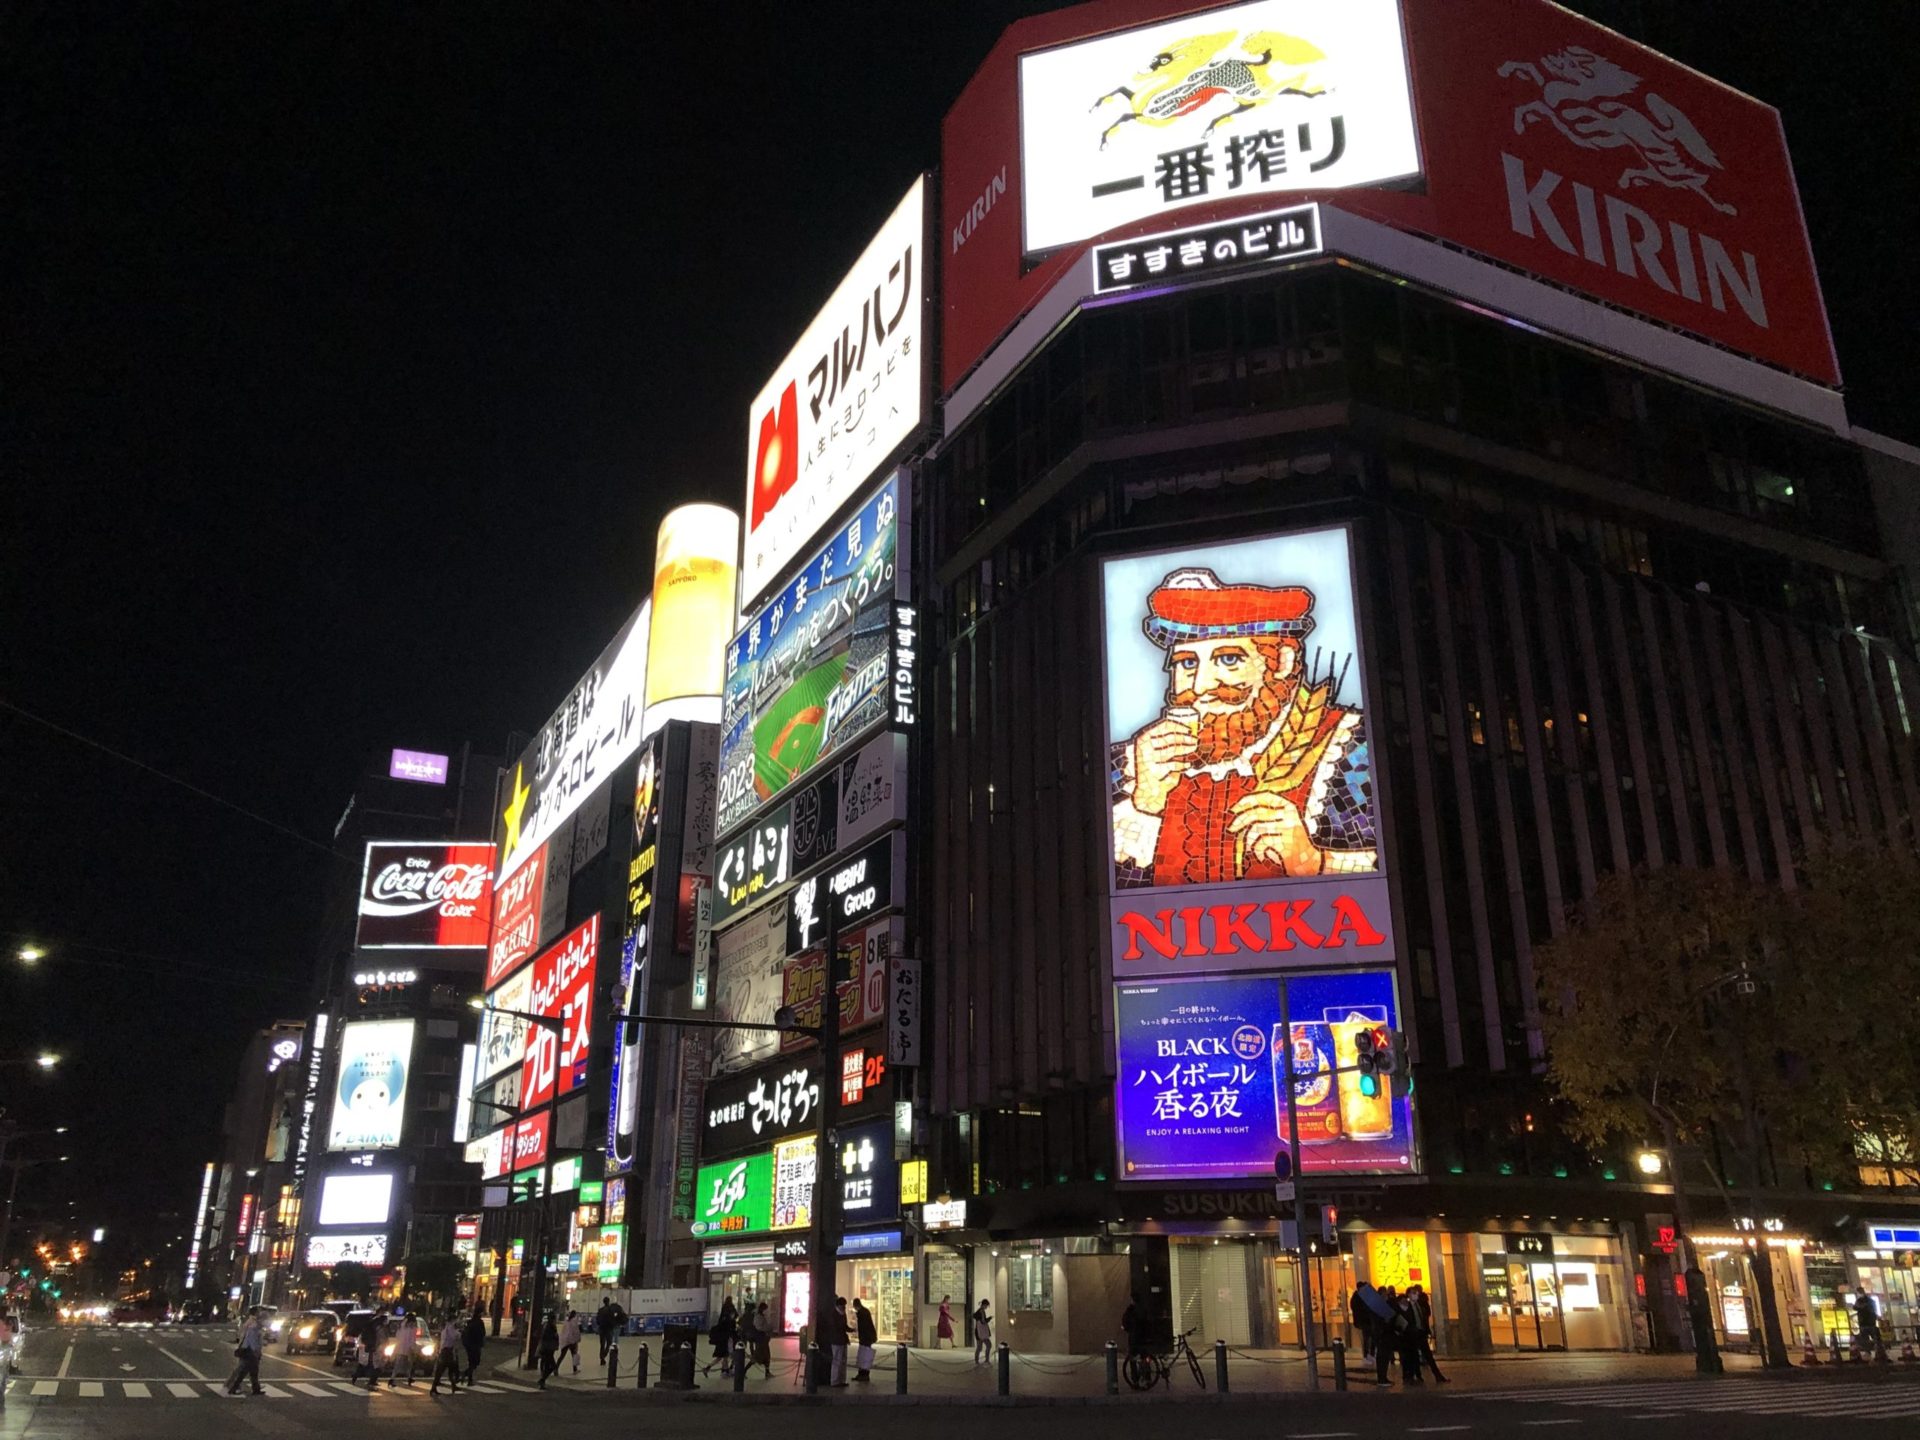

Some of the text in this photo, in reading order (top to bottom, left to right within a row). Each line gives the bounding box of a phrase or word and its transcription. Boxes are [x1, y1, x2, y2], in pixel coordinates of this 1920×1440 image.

[1091, 115, 1348, 202] 一番搾り
[953, 164, 1007, 255] KIRIN
[1108, 222, 1306, 279] すすきのビル
[1499, 153, 1770, 329] KIRIN
[807, 243, 913, 424] マルハン
[804, 335, 913, 473] 人生にヨロコビを
[727, 493, 895, 681] 世界がまだ見ぬ
[724, 549, 894, 723] ボールパークをつくろう。
[895, 607, 917, 724] すすきのビル
[818, 646, 890, 760] FIGHTERS
[530, 693, 636, 840] サッポロビール
[718, 752, 756, 812] 2023
[717, 798, 753, 828] PLAY BALL
[371, 863, 488, 900] Coca-Cola
[405, 857, 431, 869] Enjoy
[498, 859, 540, 921] カラオケ
[718, 826, 779, 900] くろねこ
[730, 872, 765, 907] Lounge
[438, 900, 477, 917] Coke
[843, 885, 876, 917] Group
[1117, 893, 1387, 962] NIKKA
[867, 930, 889, 965] 8階
[523, 981, 591, 1110] プロミス
[864, 1055, 885, 1088] 2F
[1133, 1063, 1257, 1088] ハイボール
[1156, 1037, 1230, 1057] BLACK
[1146, 1128, 1172, 1136] ENJOY
[1182, 1126, 1222, 1135] RELAXING
[1223, 1125, 1250, 1135] NIGHT
[1151, 1086, 1243, 1120] 香る夜
